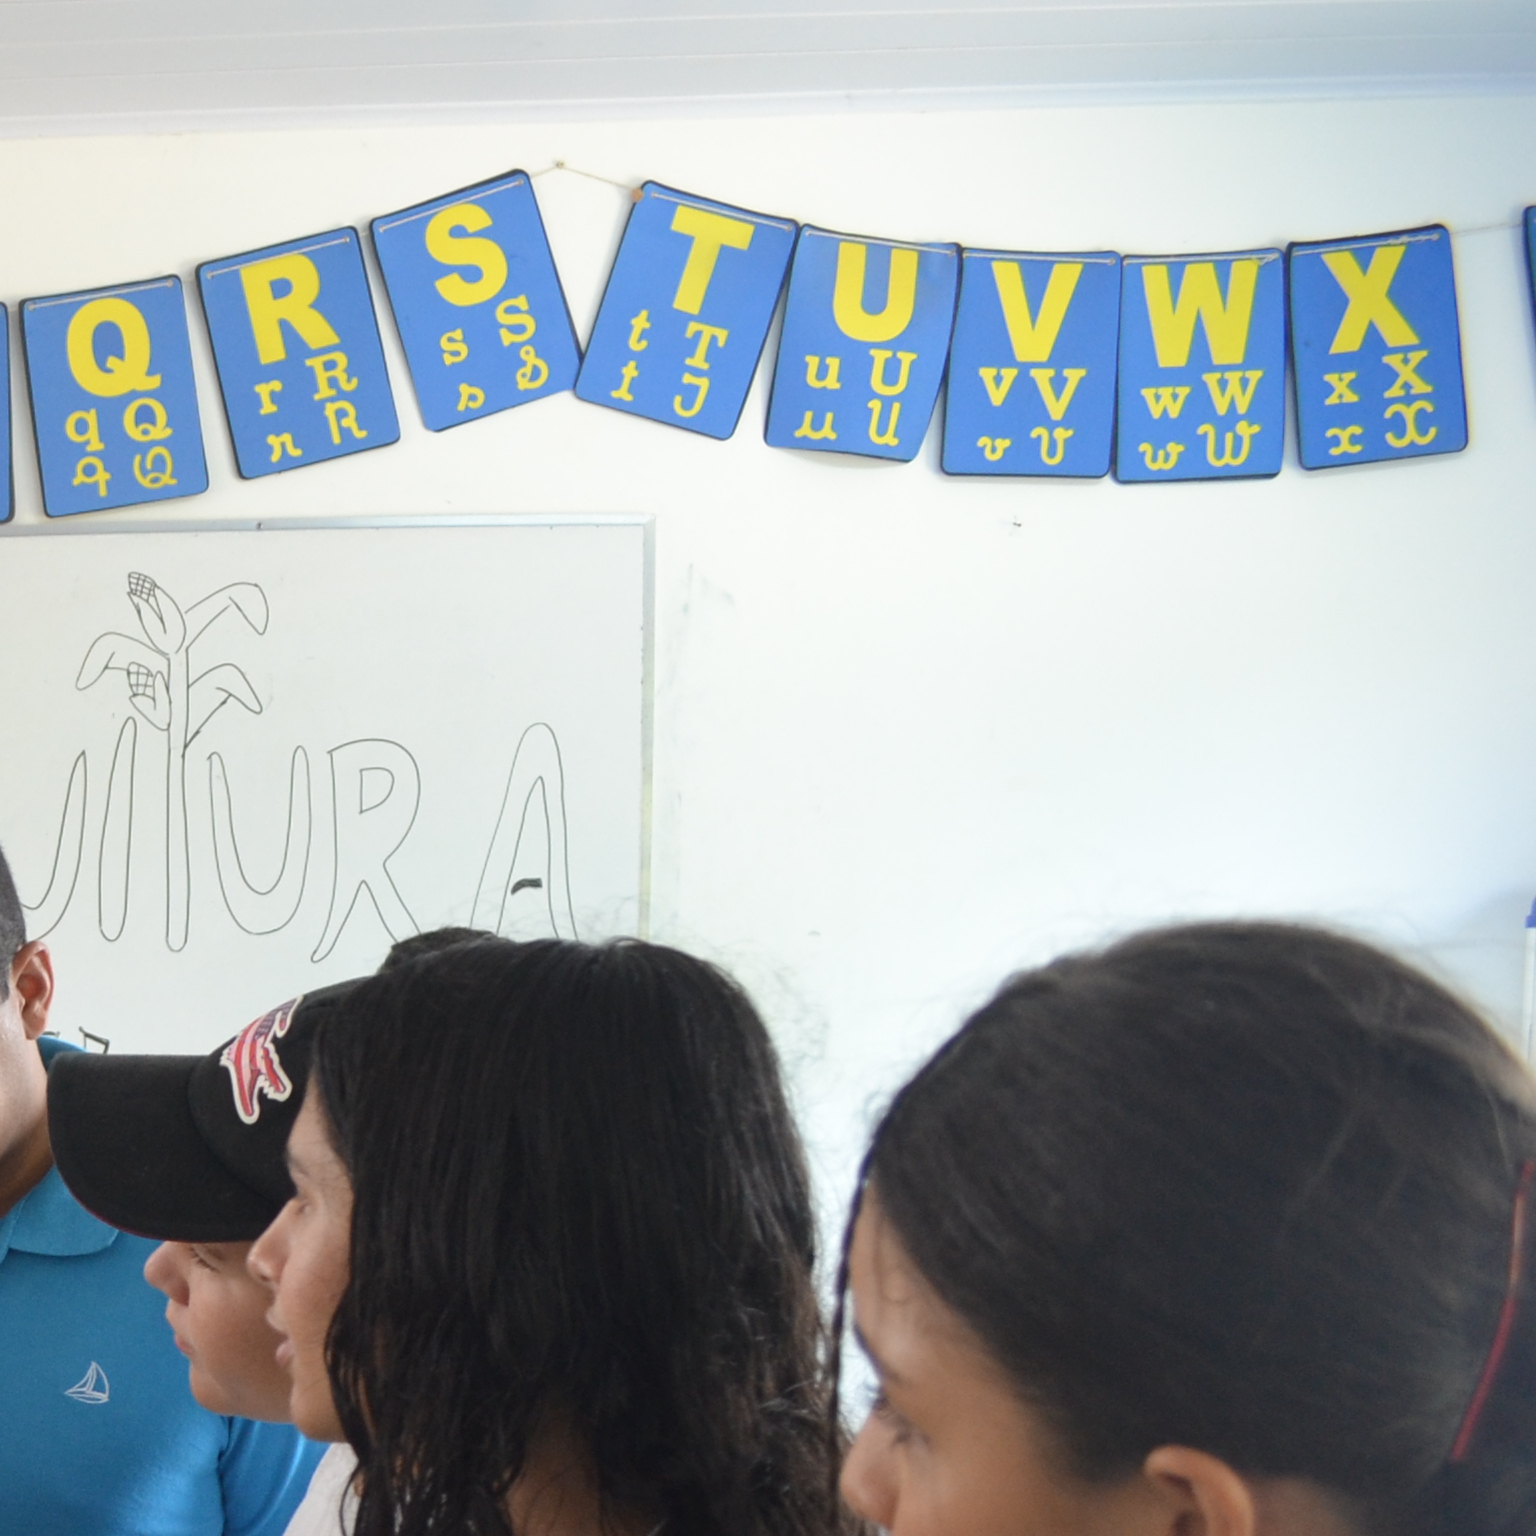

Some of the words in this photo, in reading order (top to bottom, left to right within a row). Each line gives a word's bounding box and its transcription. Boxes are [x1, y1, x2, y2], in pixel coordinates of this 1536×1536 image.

[425, 202, 508, 307] S
[671, 204, 755, 315] T
[239, 252, 340, 365] R
[833, 240, 920, 343] U
[992, 260, 1084, 363] V
[1142, 257, 1261, 368] W
[1322, 243, 1420, 354] X
[66, 296, 162, 398] Q
[439, 329, 469, 366] s
[495, 295, 537, 346] S
[628, 310, 651, 352] t
[685, 321, 729, 370] T
[254, 380, 283, 415] r
[305, 351, 359, 401] R
[457, 383, 485, 411] s
[611, 361, 639, 402] t
[805, 355, 841, 390] u
[870, 348, 918, 396] U
[979, 367, 1019, 406] v
[1030, 368, 1087, 421] V
[1142, 386, 1191, 419] w
[1203, 370, 1264, 415] W
[1325, 371, 1359, 405] x
[1384, 350, 1433, 398] X
[65, 409, 105, 452] q
[123, 397, 173, 443] Q
[266, 432, 303, 463] r
[795, 411, 837, 440] u
[978, 436, 1012, 461] v
[1327, 425, 1363, 455] x
[72, 456, 112, 497] q
[1139, 442, 1185, 470] w
